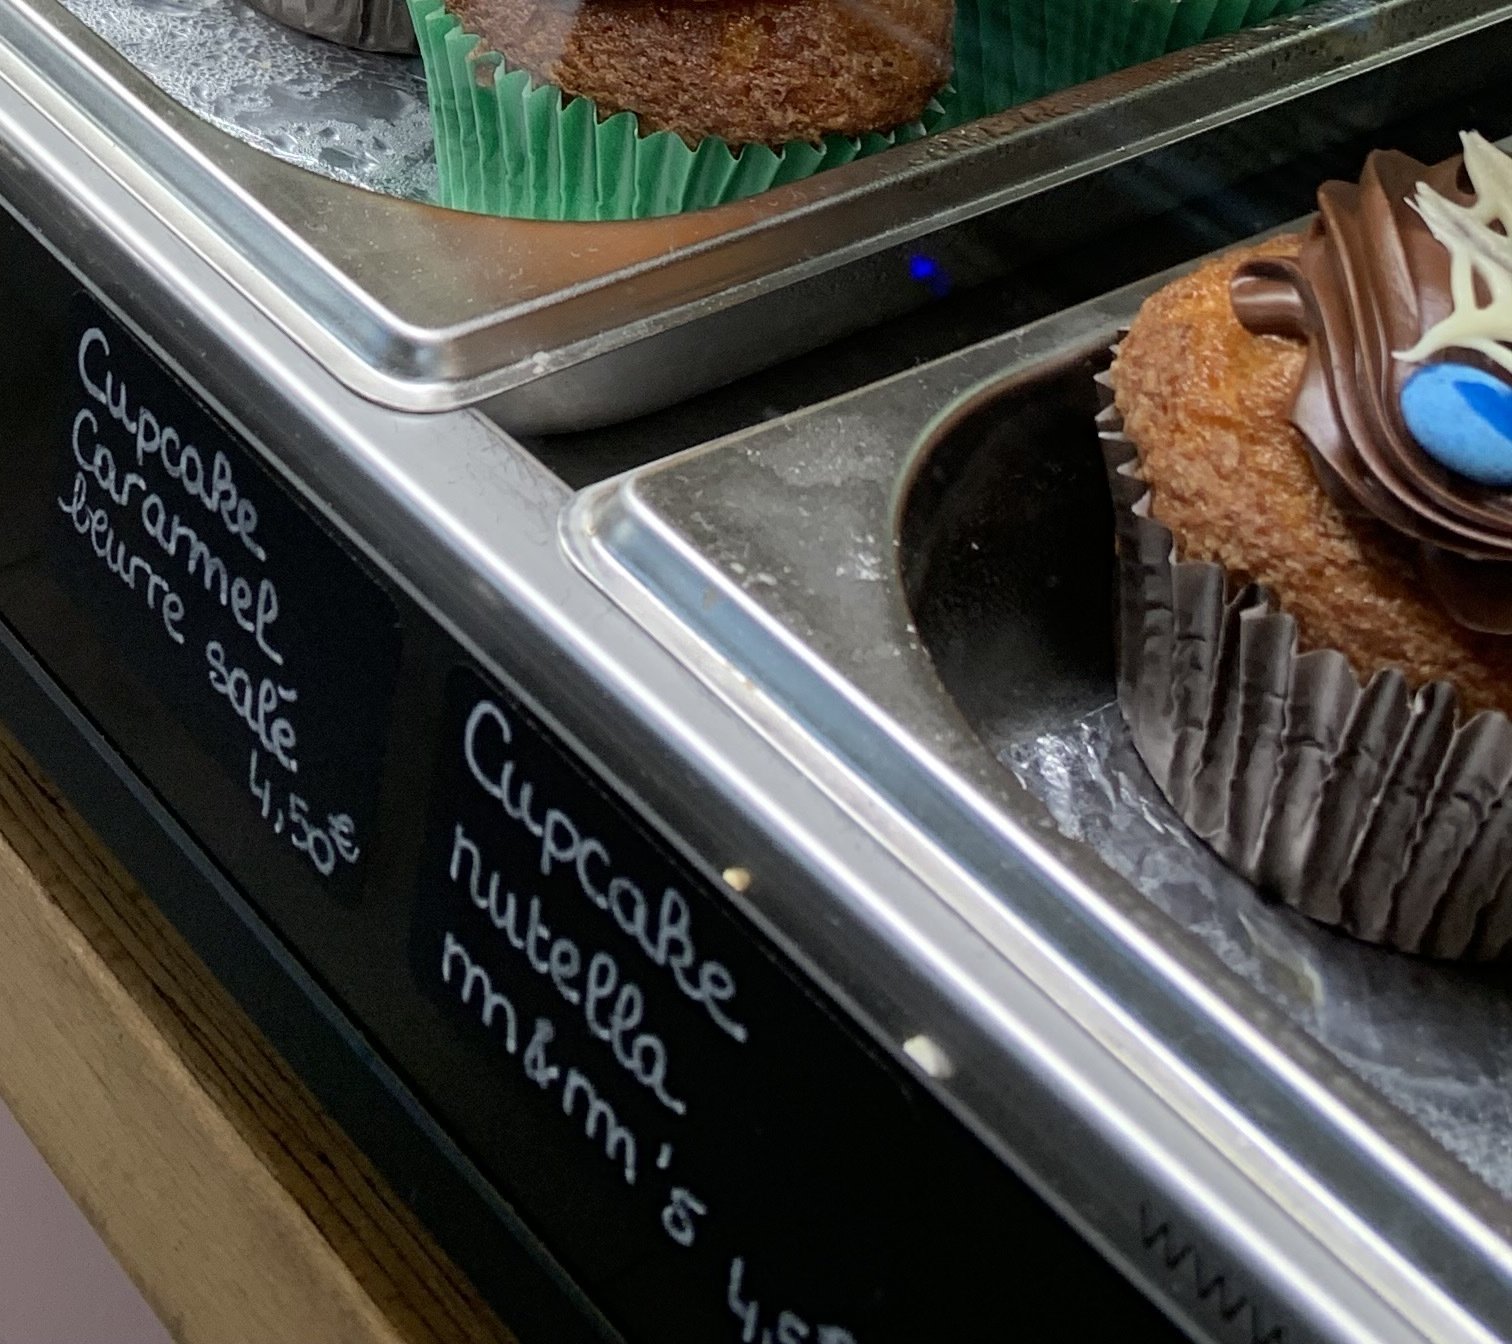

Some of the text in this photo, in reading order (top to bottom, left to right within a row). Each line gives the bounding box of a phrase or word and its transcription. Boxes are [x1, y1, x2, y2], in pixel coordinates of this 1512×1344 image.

[77, 325, 266, 563] Cupcake
[58, 471, 298, 773] beurre salé
[448, 823, 687, 1116] nutella
[463, 698, 748, 1044] Cupcake
[441, 929, 709, 1247] m&m's
